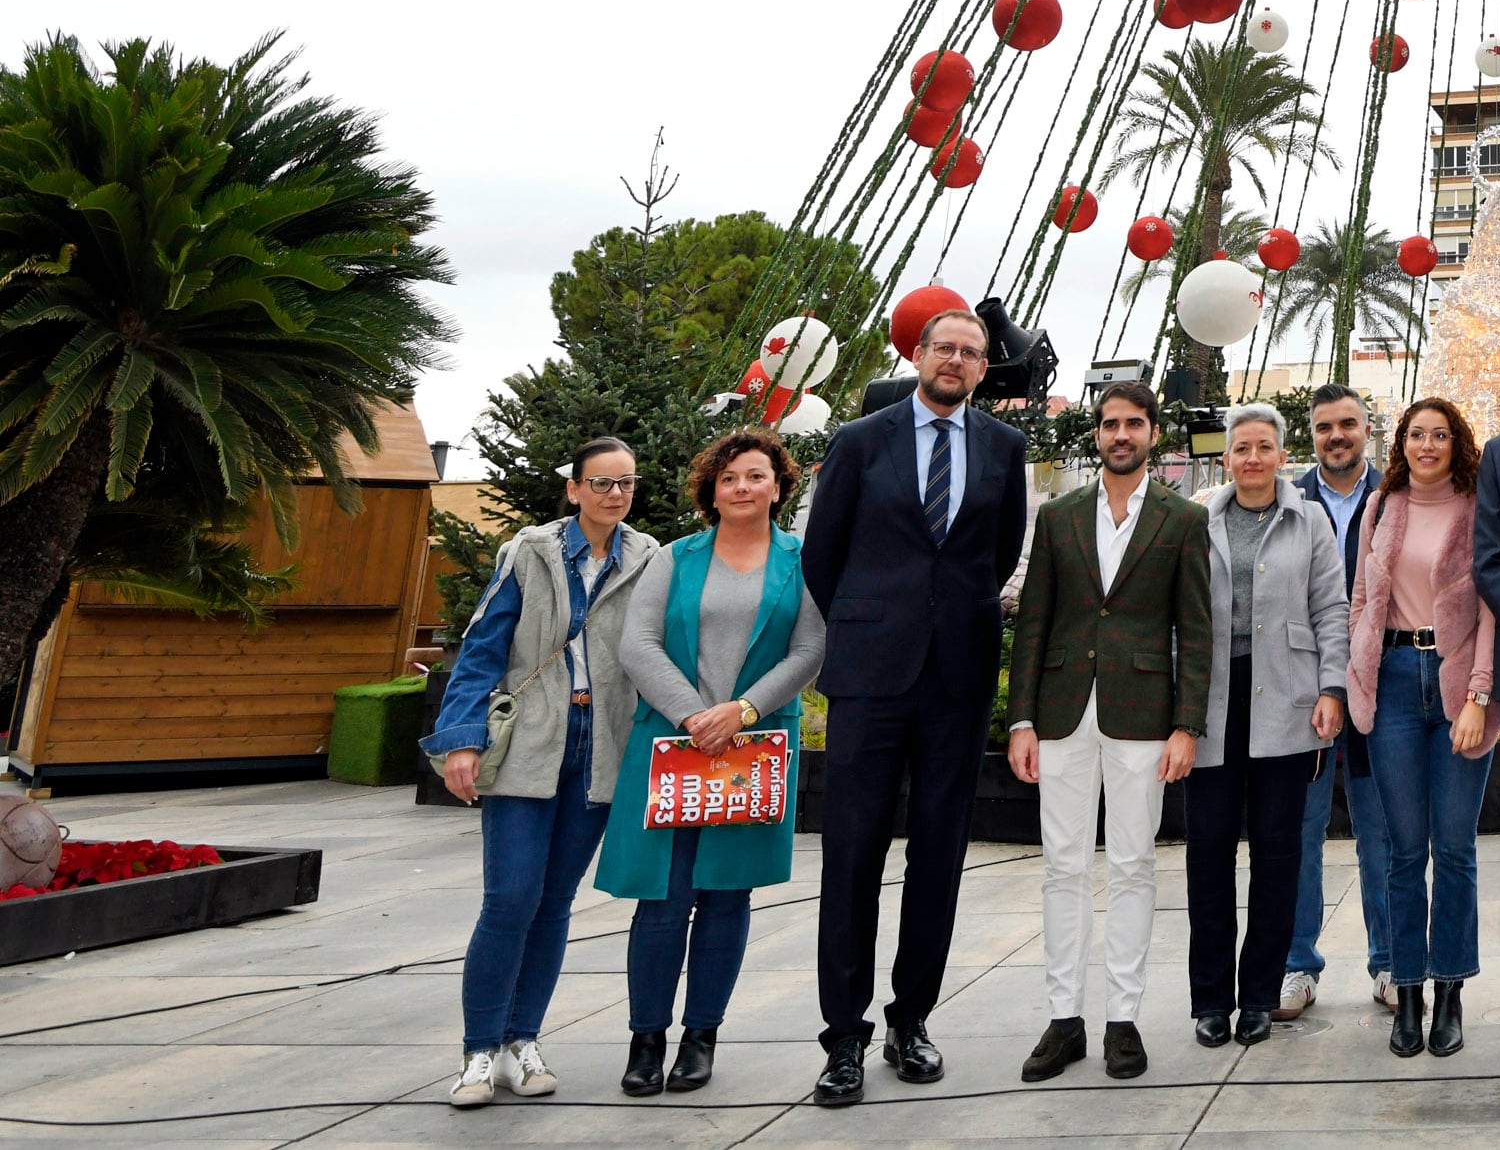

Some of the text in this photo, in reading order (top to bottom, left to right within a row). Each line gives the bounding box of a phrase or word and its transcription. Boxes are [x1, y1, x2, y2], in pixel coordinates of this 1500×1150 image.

[654, 772, 676, 824] 2023
[680, 774, 702, 823] MAR
[703, 778, 725, 822] PAL
[726, 792, 747, 820] EL
[749, 761, 764, 818] navidad
